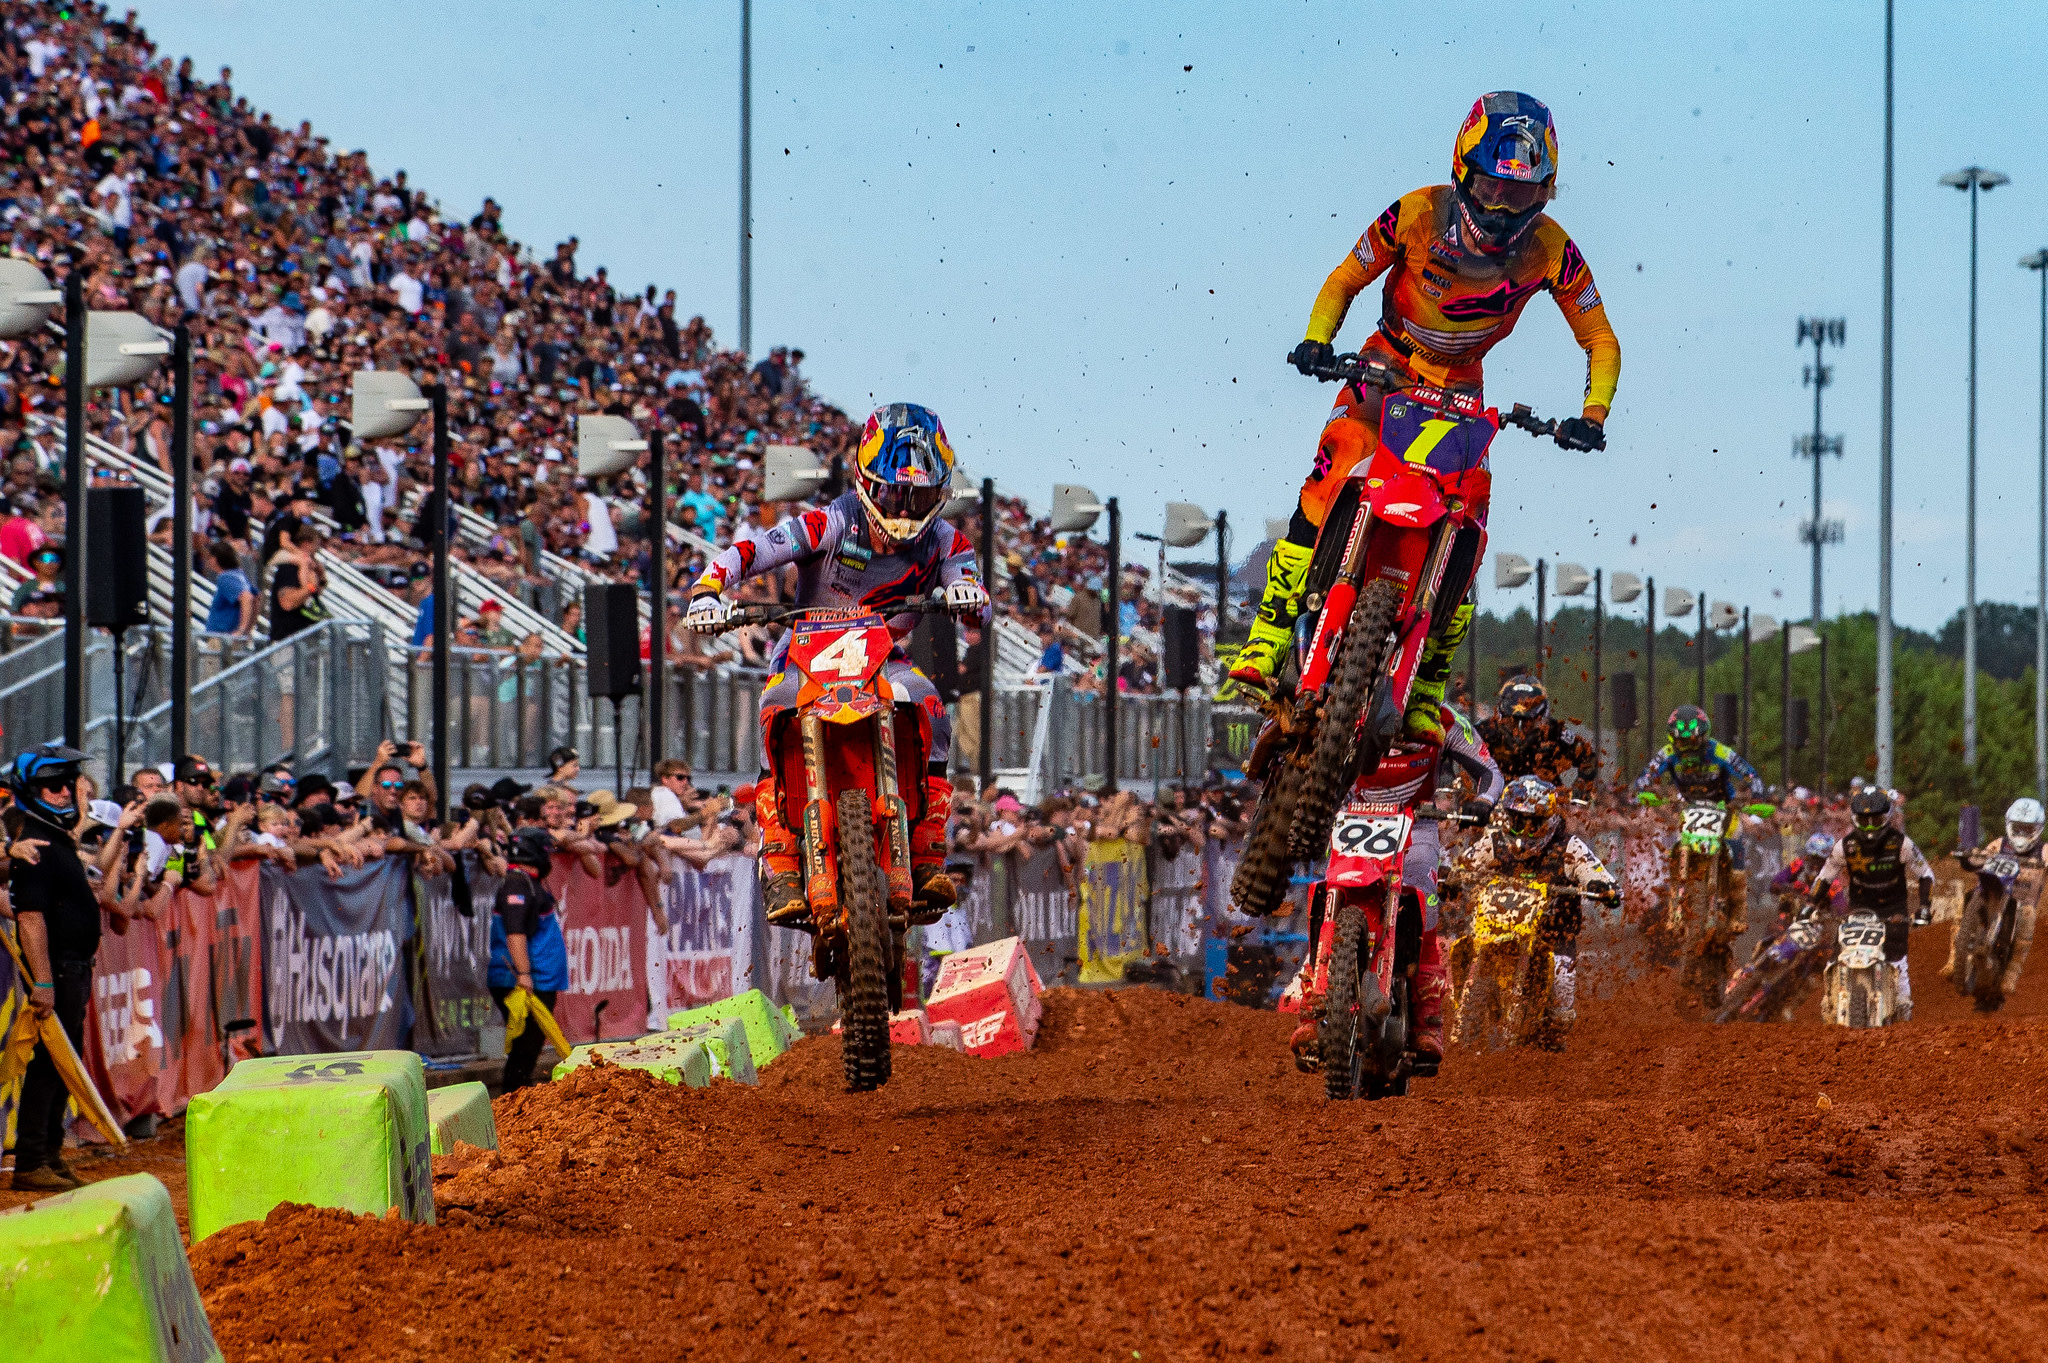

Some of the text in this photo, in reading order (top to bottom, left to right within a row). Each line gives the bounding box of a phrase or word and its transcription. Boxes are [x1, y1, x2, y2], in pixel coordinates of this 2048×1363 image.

[1403, 418, 1459, 465] 1
[1409, 462, 1437, 475] HONDA
[1383, 509, 1418, 523] HONDA
[810, 629, 869, 678] 4
[1303, 607, 1328, 676] DUNLOP
[1402, 636, 1425, 709] DUNLOP
[1685, 811, 1721, 833] 22
[1338, 823, 1398, 855] 96
[1842, 929, 1885, 946] 28
